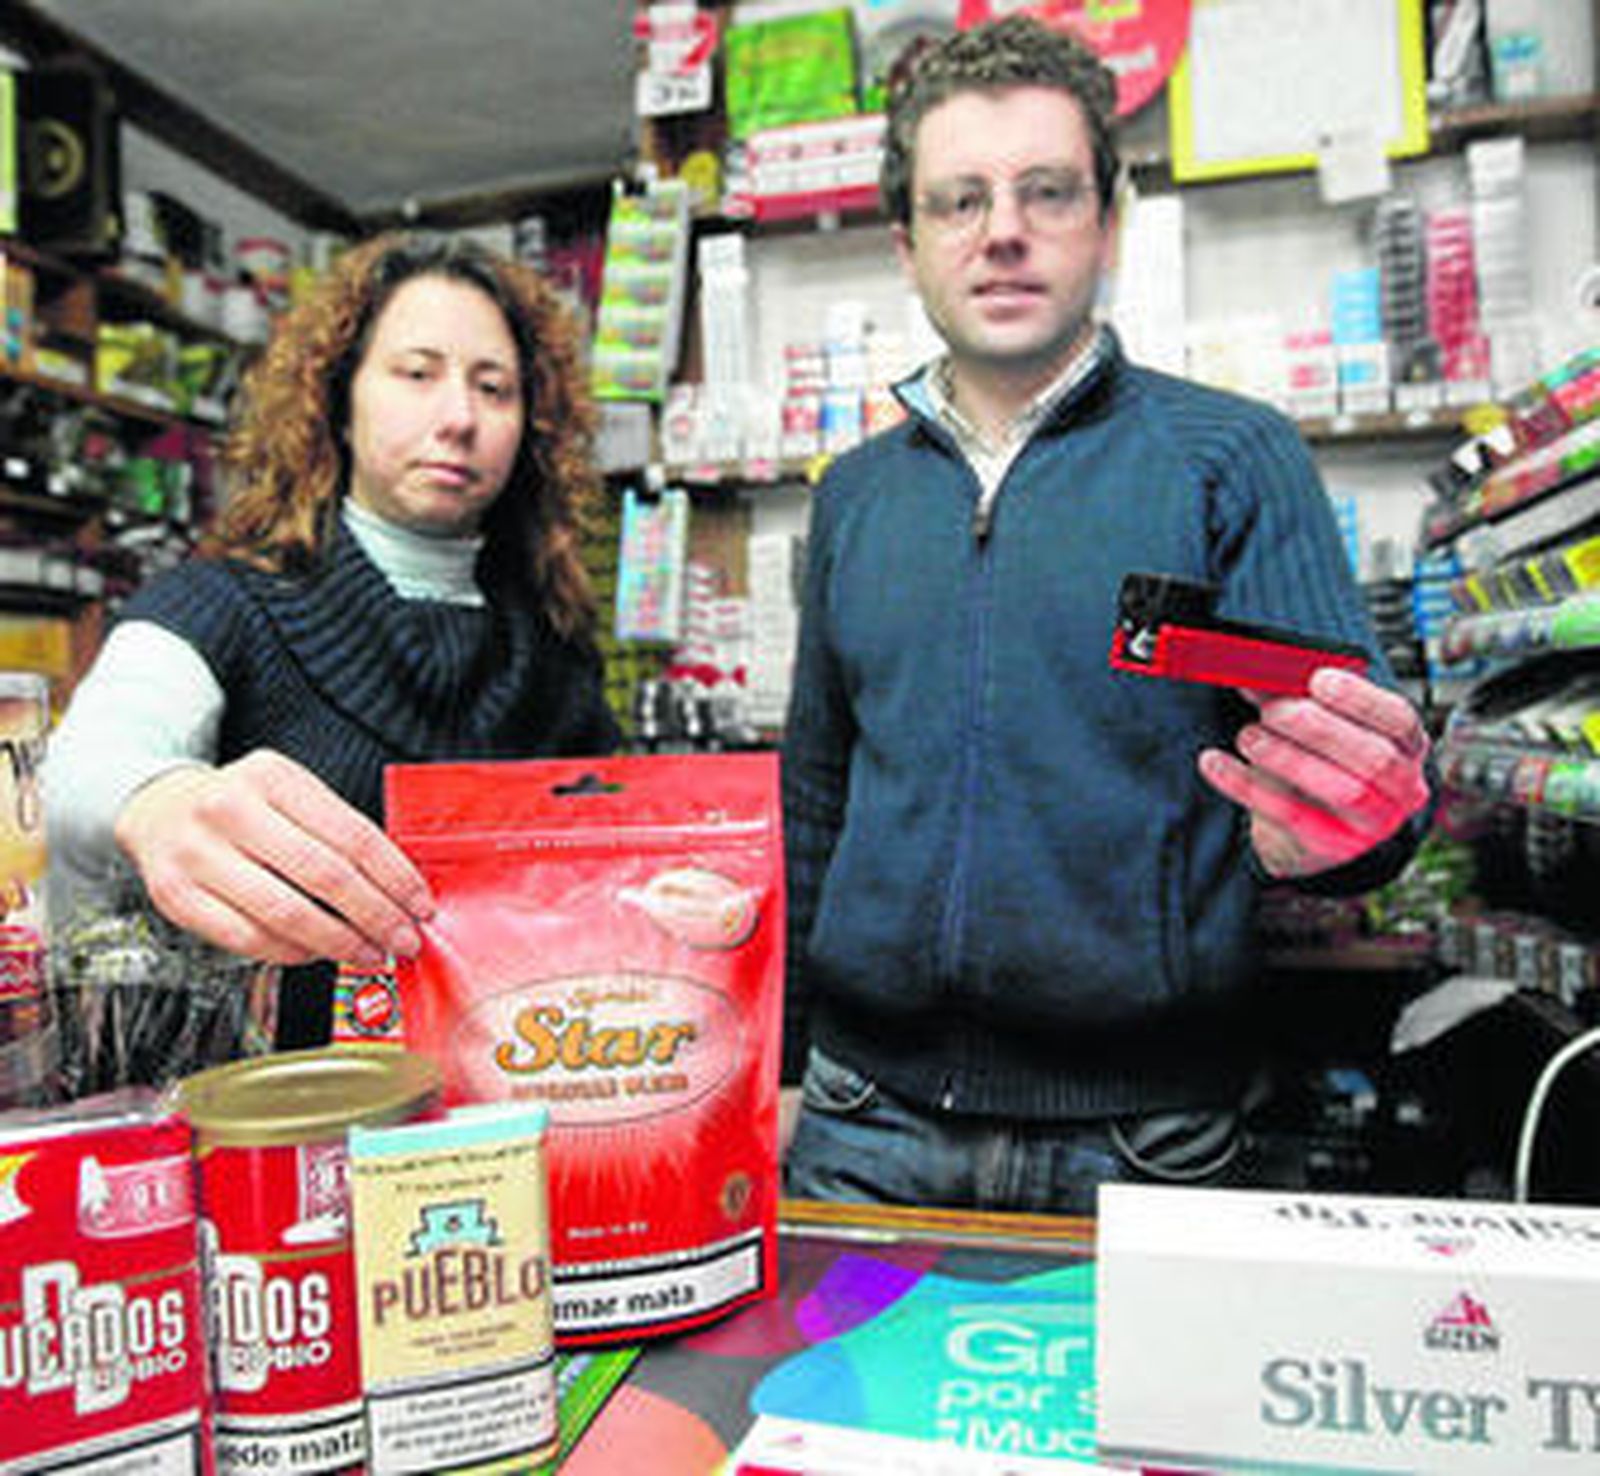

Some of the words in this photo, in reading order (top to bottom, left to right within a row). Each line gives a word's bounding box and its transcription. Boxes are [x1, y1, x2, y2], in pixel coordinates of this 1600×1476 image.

[495, 1006, 696, 1073] Star
[372, 1247, 545, 1326] PUEBLO
[627, 1285, 694, 1310] mata
[945, 1321, 1089, 1376] Gr
[936, 1380, 1056, 1414] por
[1260, 1357, 1507, 1445] Silver
